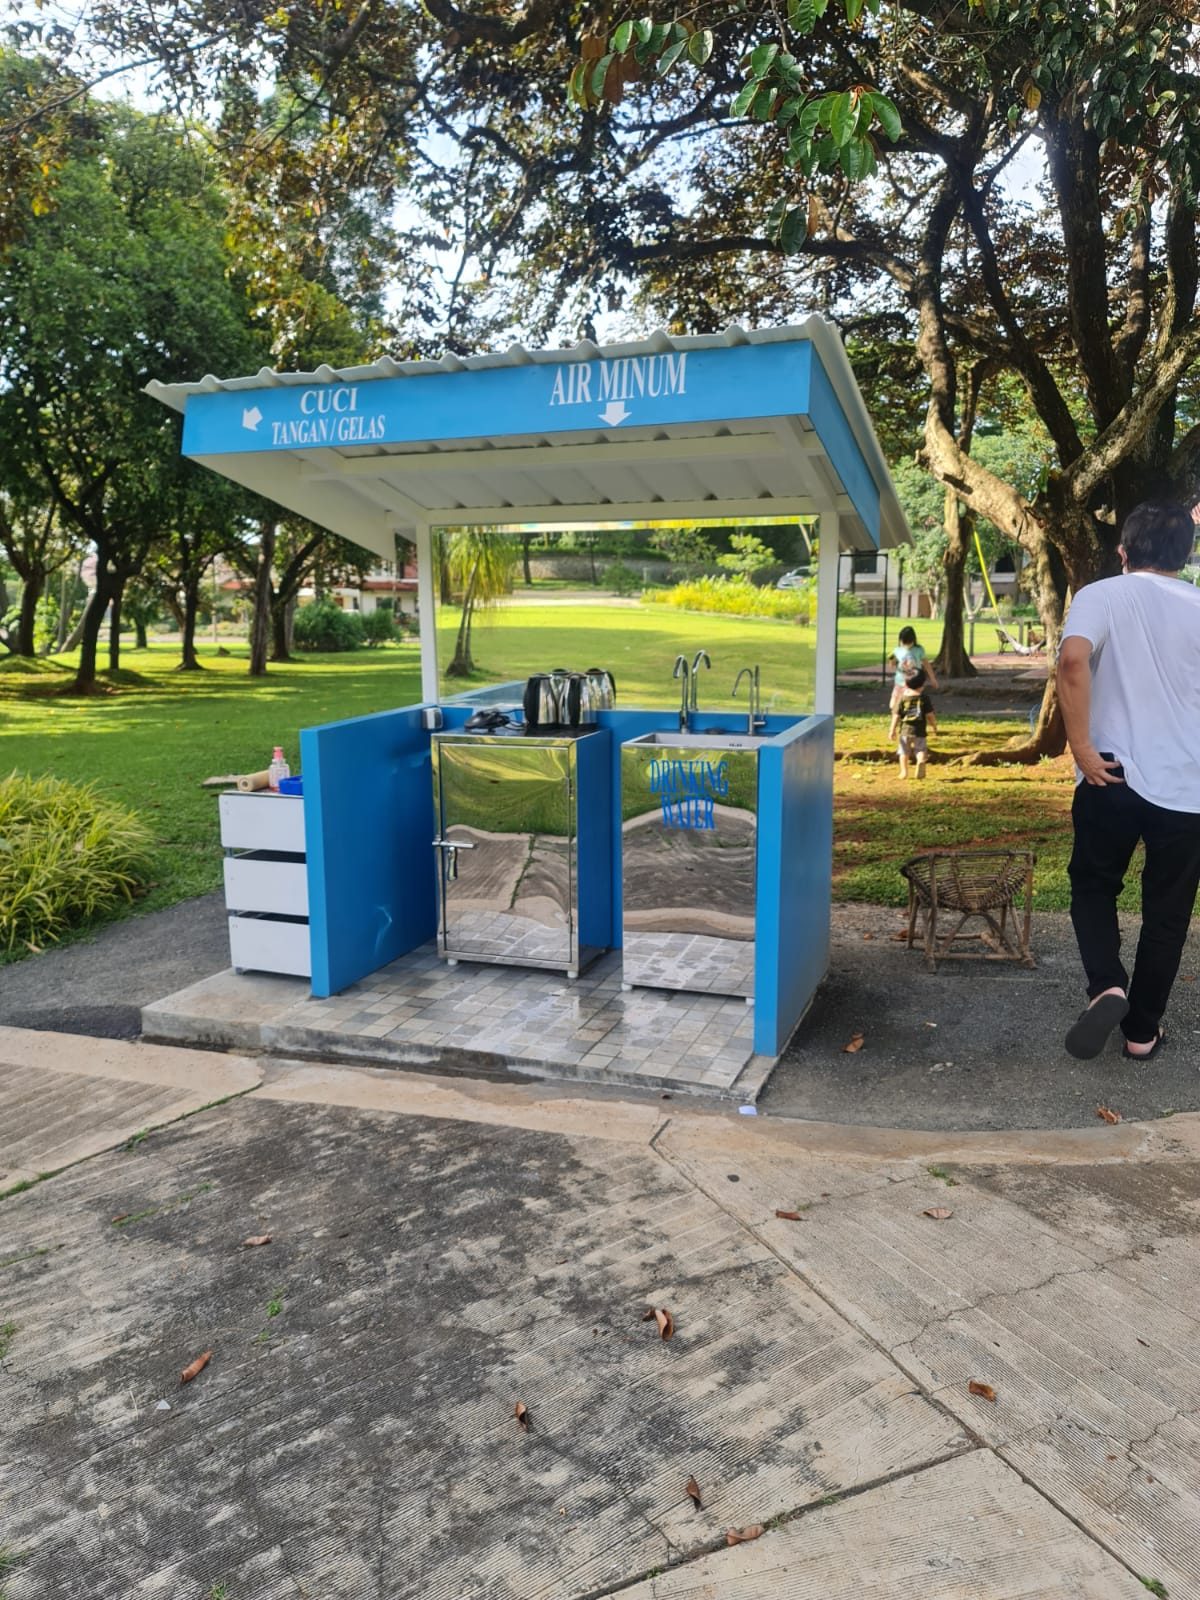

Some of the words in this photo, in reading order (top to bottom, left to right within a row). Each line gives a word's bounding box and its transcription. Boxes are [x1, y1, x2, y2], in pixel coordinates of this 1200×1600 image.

[550, 363, 592, 406] AIR
[597, 352, 688, 401] MINUM
[300, 387, 359, 415] CUCI
[650, 759, 729, 797] DRINKING
[660, 794, 715, 830] WATER
